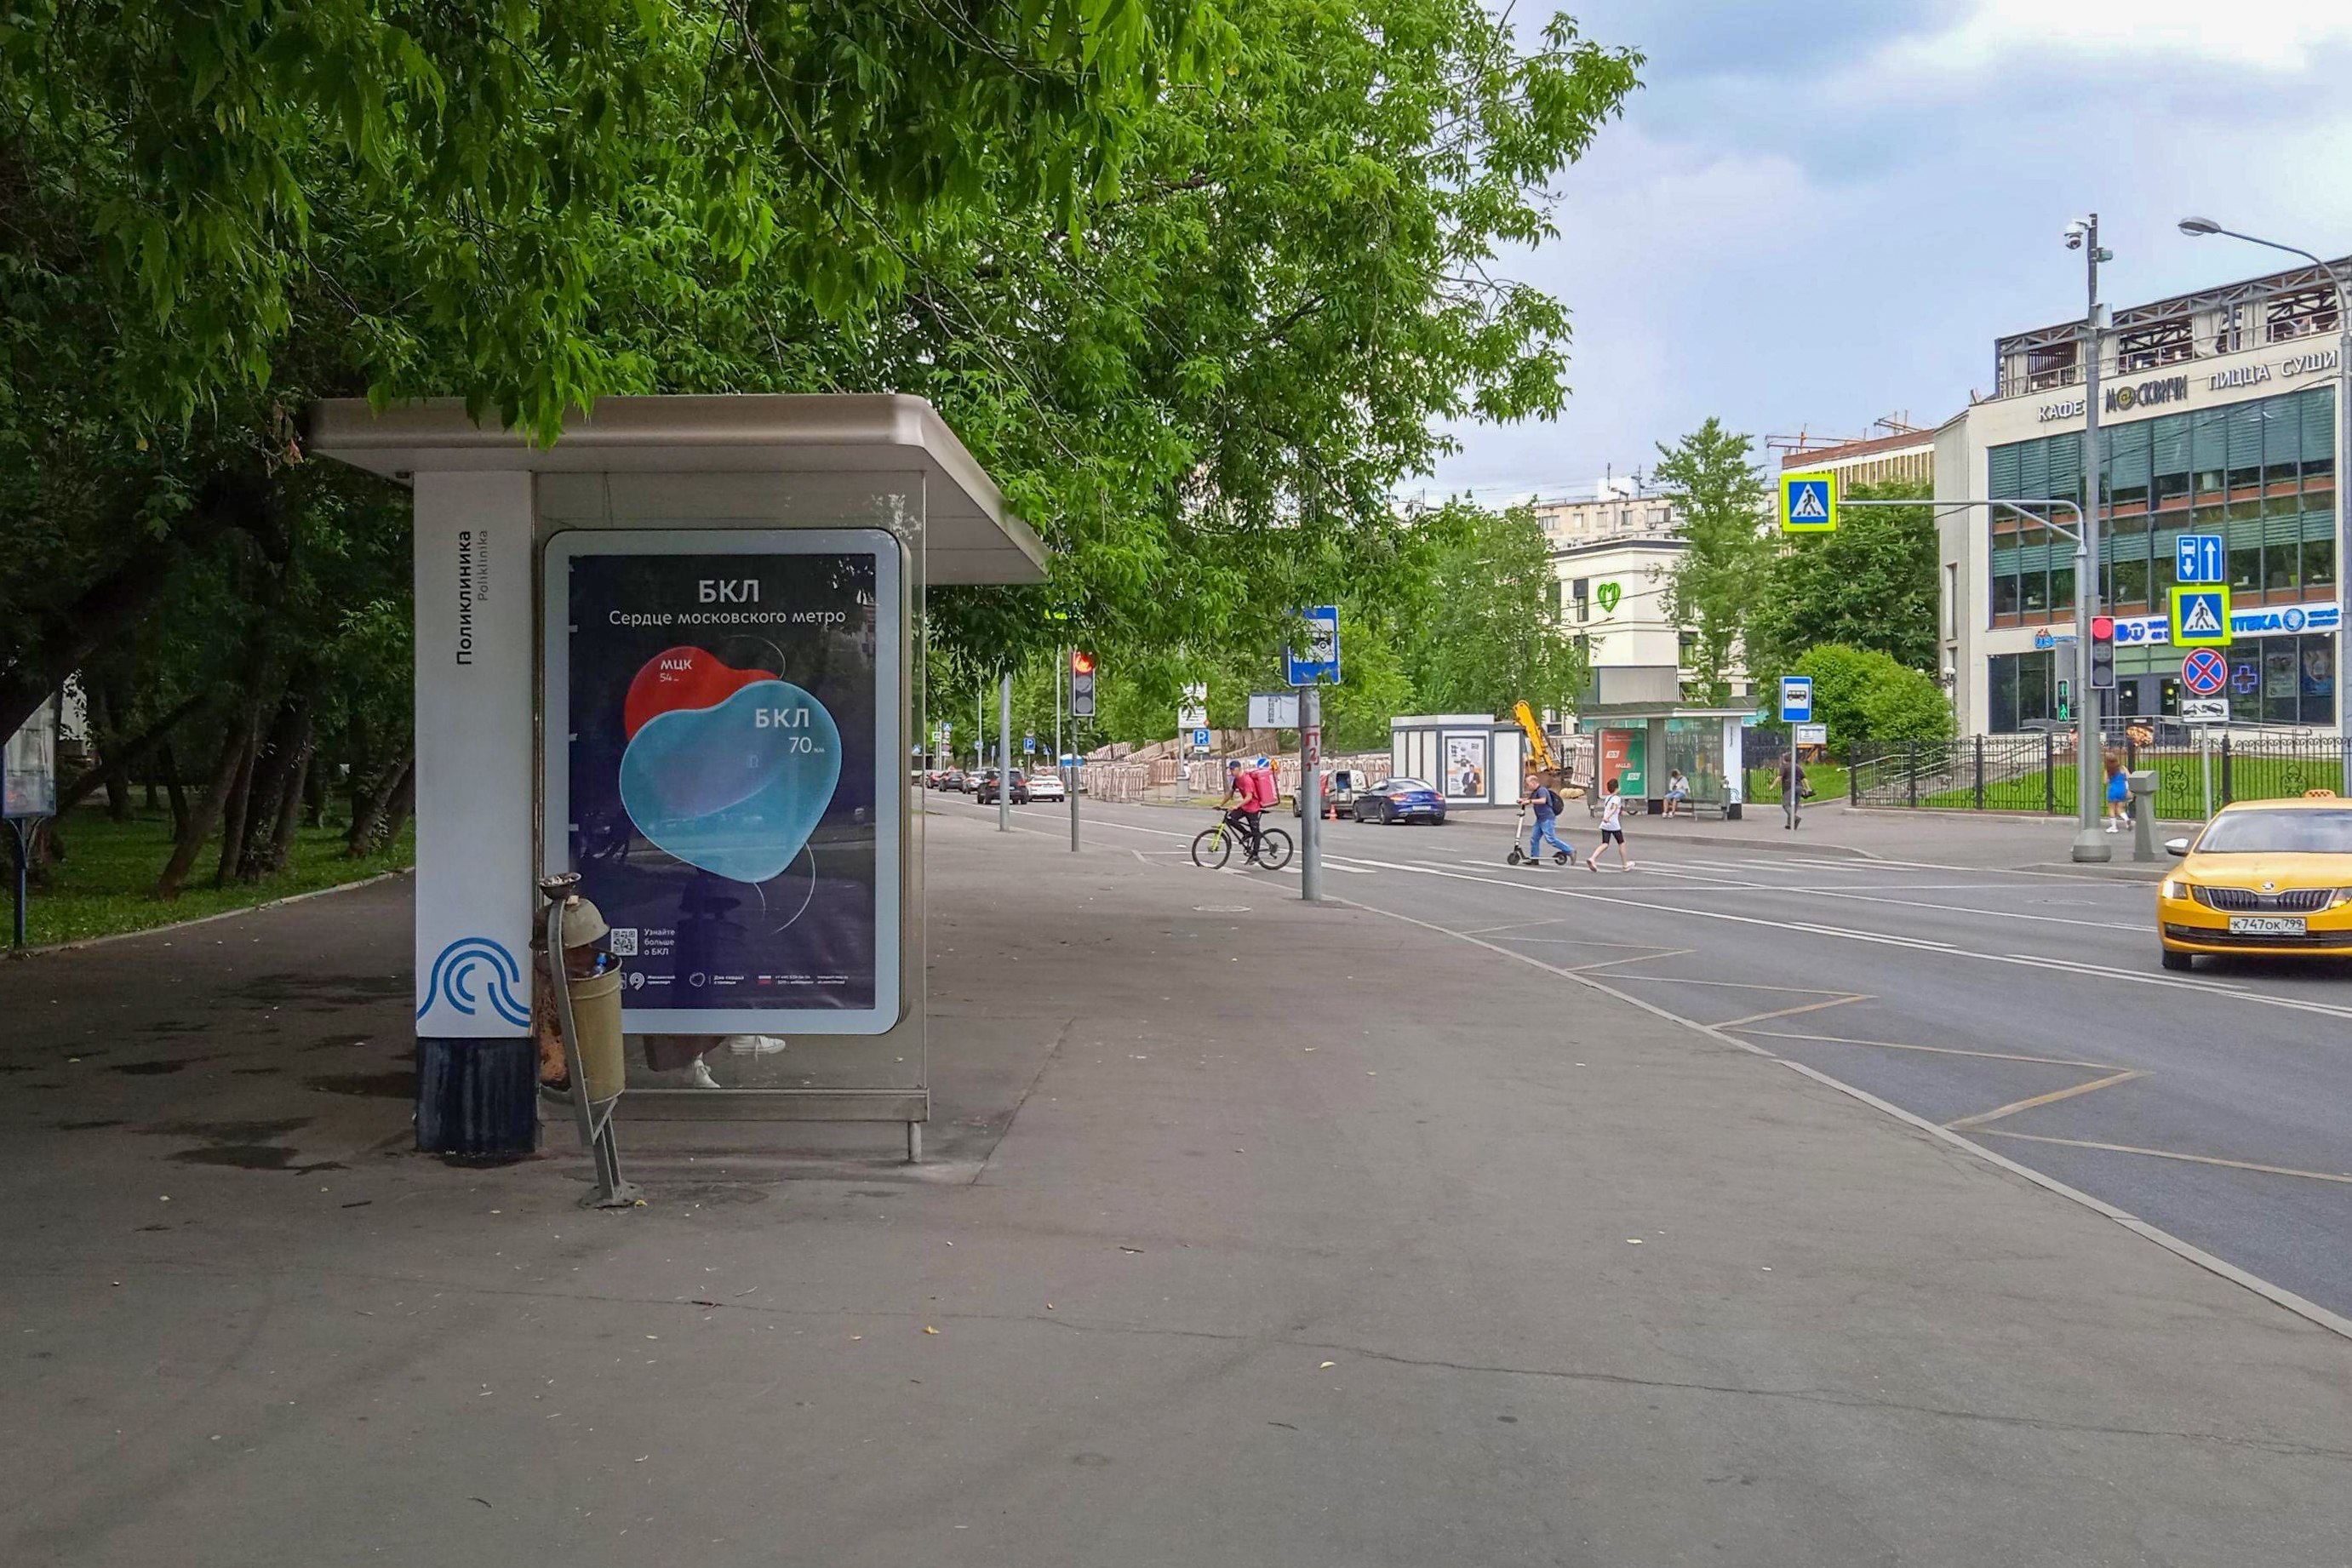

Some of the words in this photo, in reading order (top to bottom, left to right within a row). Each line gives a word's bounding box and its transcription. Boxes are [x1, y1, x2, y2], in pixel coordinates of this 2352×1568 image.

[2208, 364, 2271, 391] ПИЦЦА
[2280, 351, 2337, 377] СУШИ
[2037, 400, 2085, 421] КАФЕ
[477, 529, 489, 601] Poliklinika
[456, 530, 472, 665] Поликлиника
[698, 579, 759, 603] БКЛ
[609, 609, 672, 627] Сердце
[678, 611, 787, 625] московского
[792, 610, 846, 625] метро
[661, 659, 693, 670] МЦК
[755, 708, 810, 728] БКЛ
[788, 736, 812, 753] 70
[644, 928, 675, 936] Узнайте
